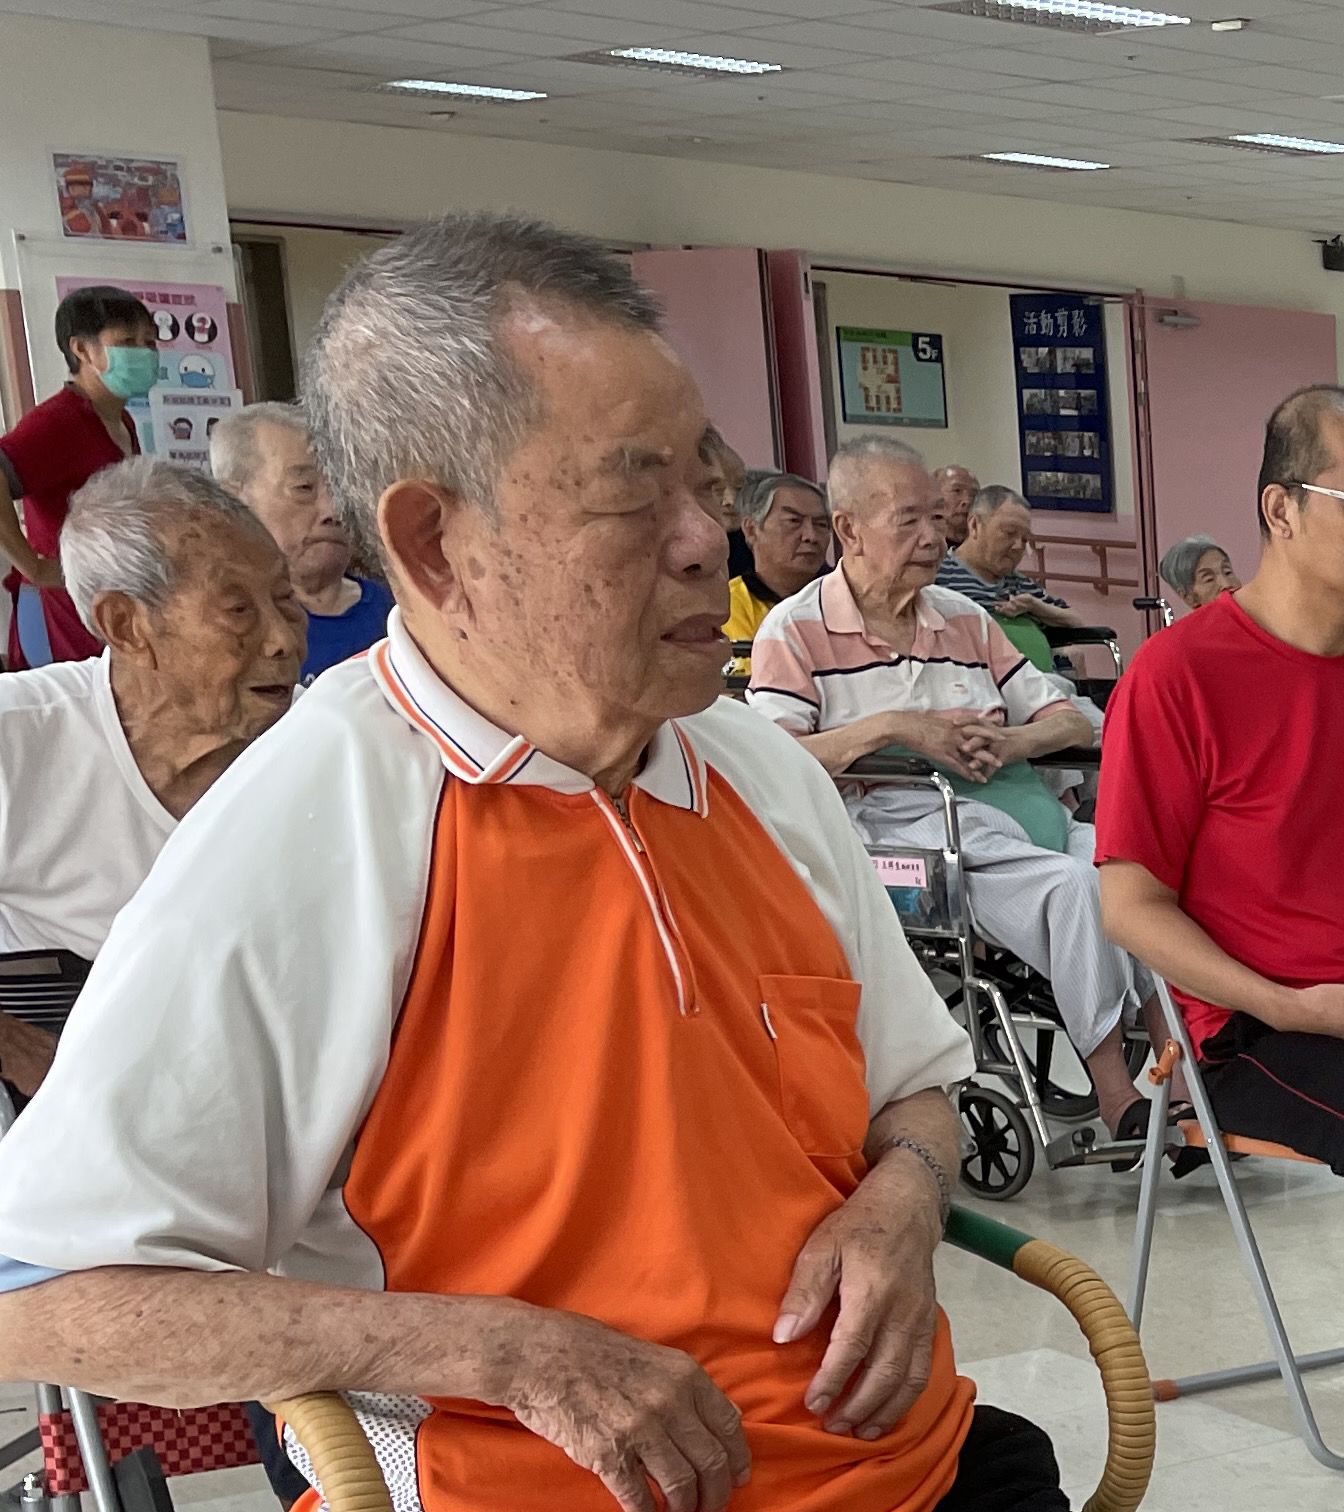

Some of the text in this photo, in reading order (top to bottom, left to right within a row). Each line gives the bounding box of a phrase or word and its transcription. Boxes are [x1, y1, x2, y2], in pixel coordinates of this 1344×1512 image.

[1023, 307, 1088, 338] 活動剪影
[917, 336, 939, 360] 5F
